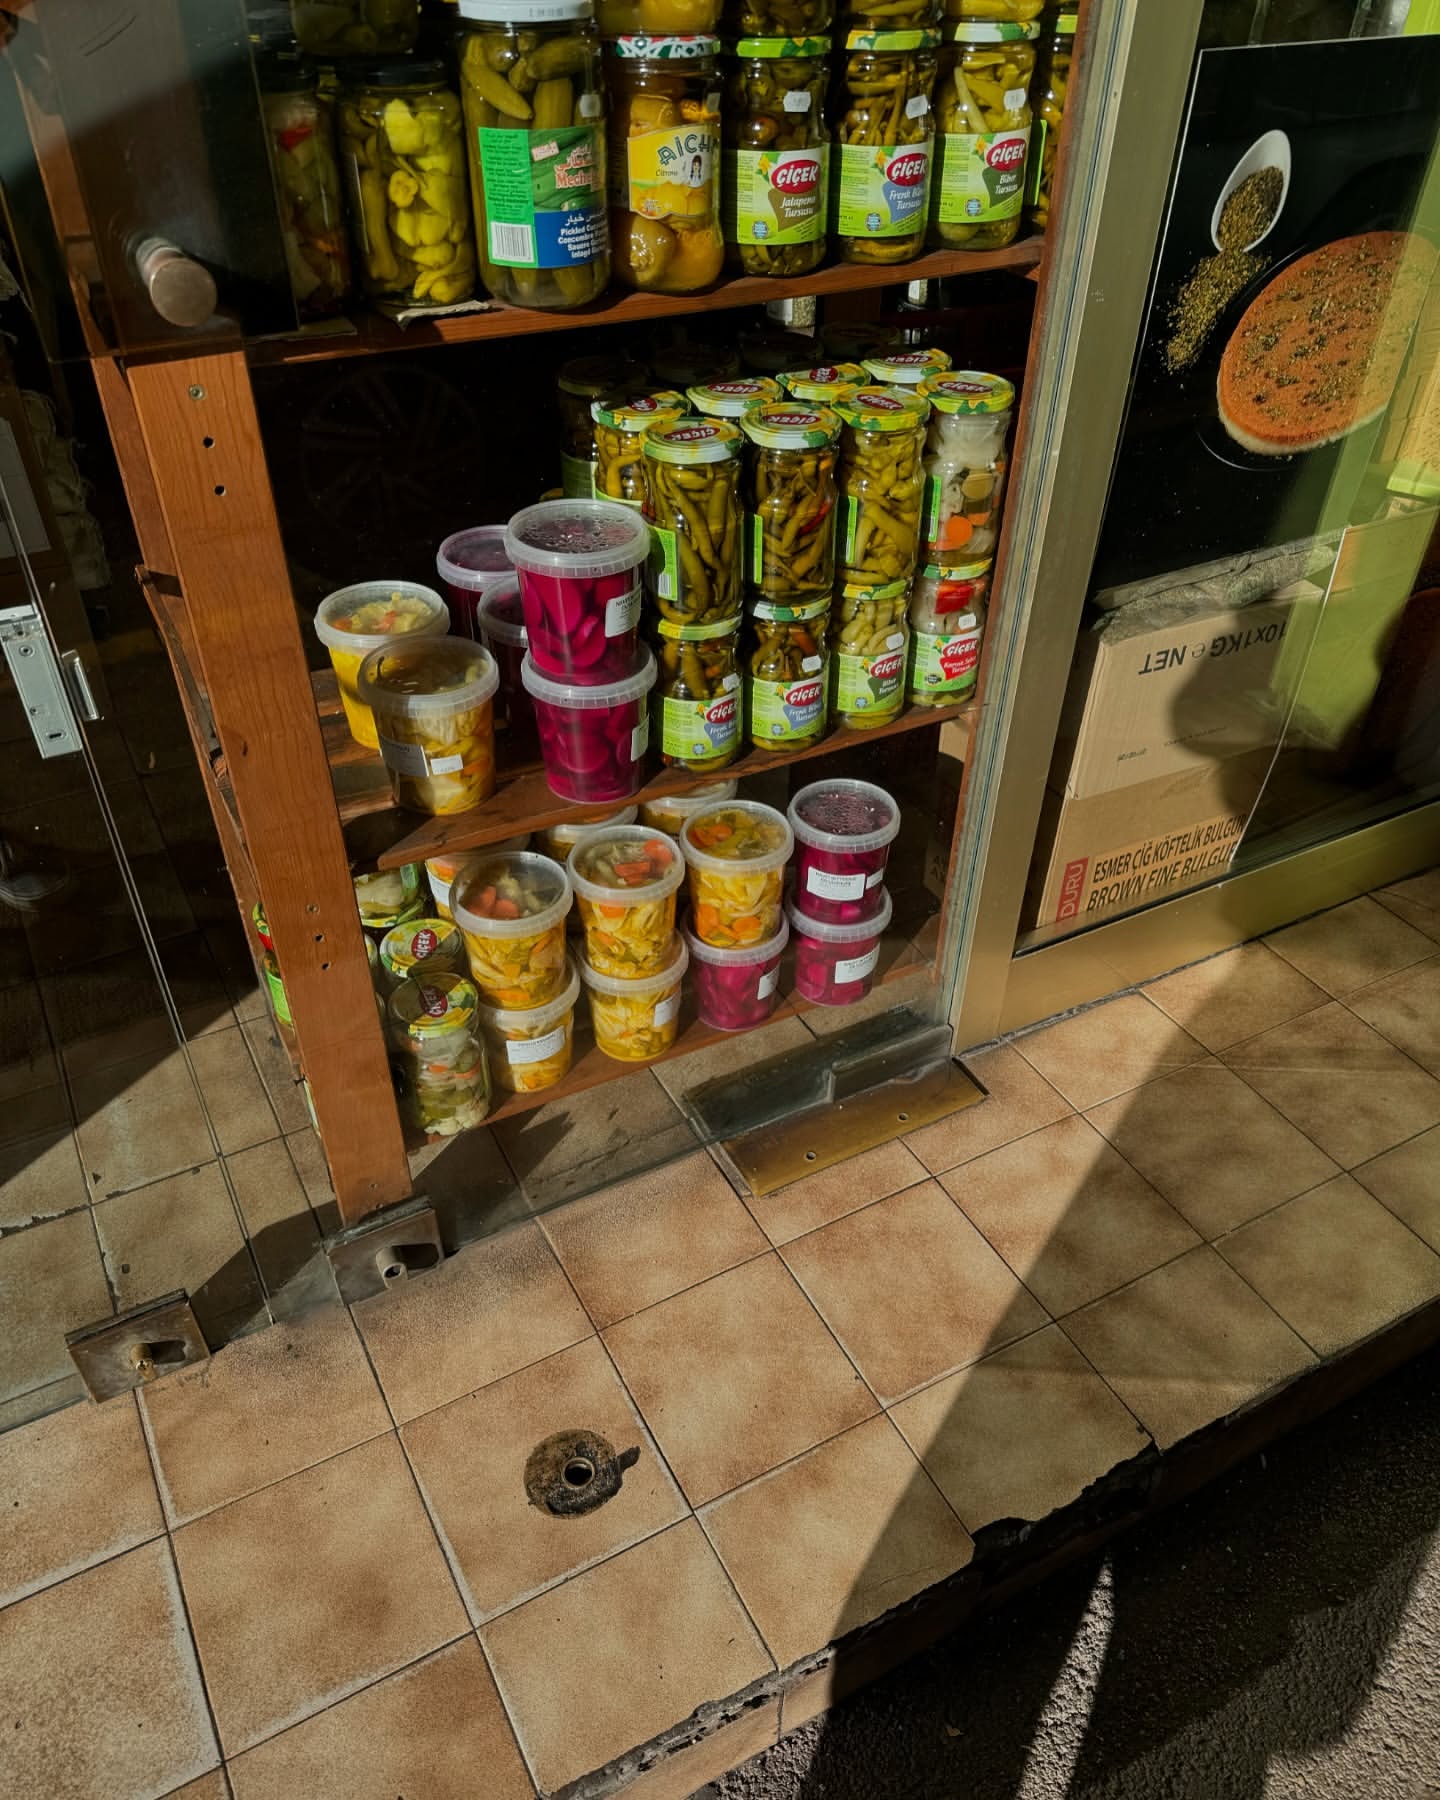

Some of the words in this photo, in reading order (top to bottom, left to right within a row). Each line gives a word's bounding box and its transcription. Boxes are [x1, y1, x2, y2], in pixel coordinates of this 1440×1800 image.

[1138, 645, 1187, 675] NET
[1093, 852, 1131, 884] ESMER
[1132, 842, 1152, 873] ÇİĞ
[1152, 825, 1203, 865] KÖFTELİK
[1060, 863, 1083, 918] DURU
[1086, 871, 1146, 912] BROWN
[1146, 859, 1182, 890] FINE
